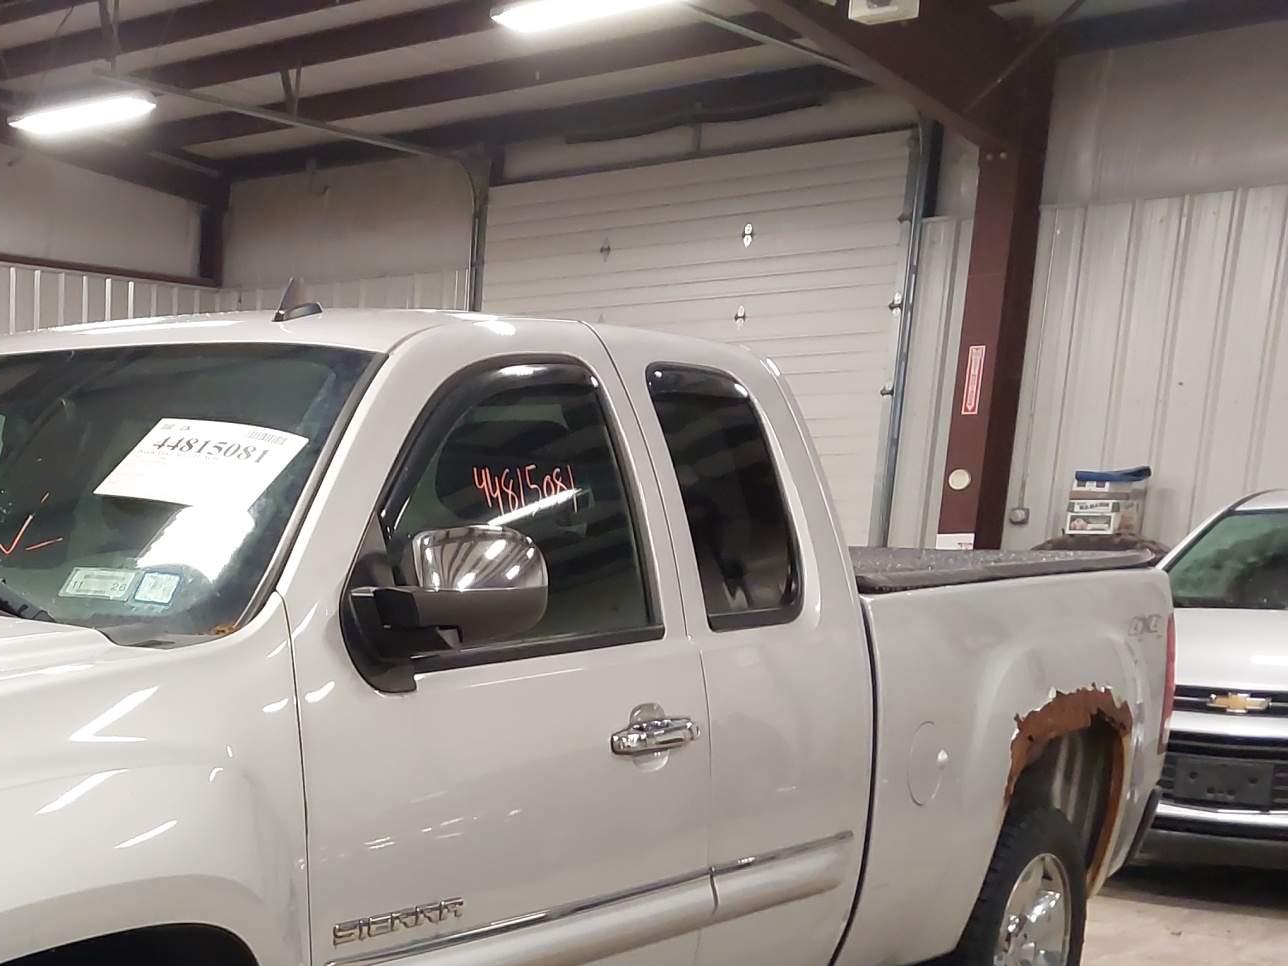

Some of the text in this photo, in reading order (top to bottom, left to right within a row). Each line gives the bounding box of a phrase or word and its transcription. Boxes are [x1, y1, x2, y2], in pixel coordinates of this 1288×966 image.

[153, 435, 270, 463] 44815081
[473, 464, 578, 516] 44815081
[110, 582, 128, 592] 26
[332, 896, 465, 947] SIERRA
